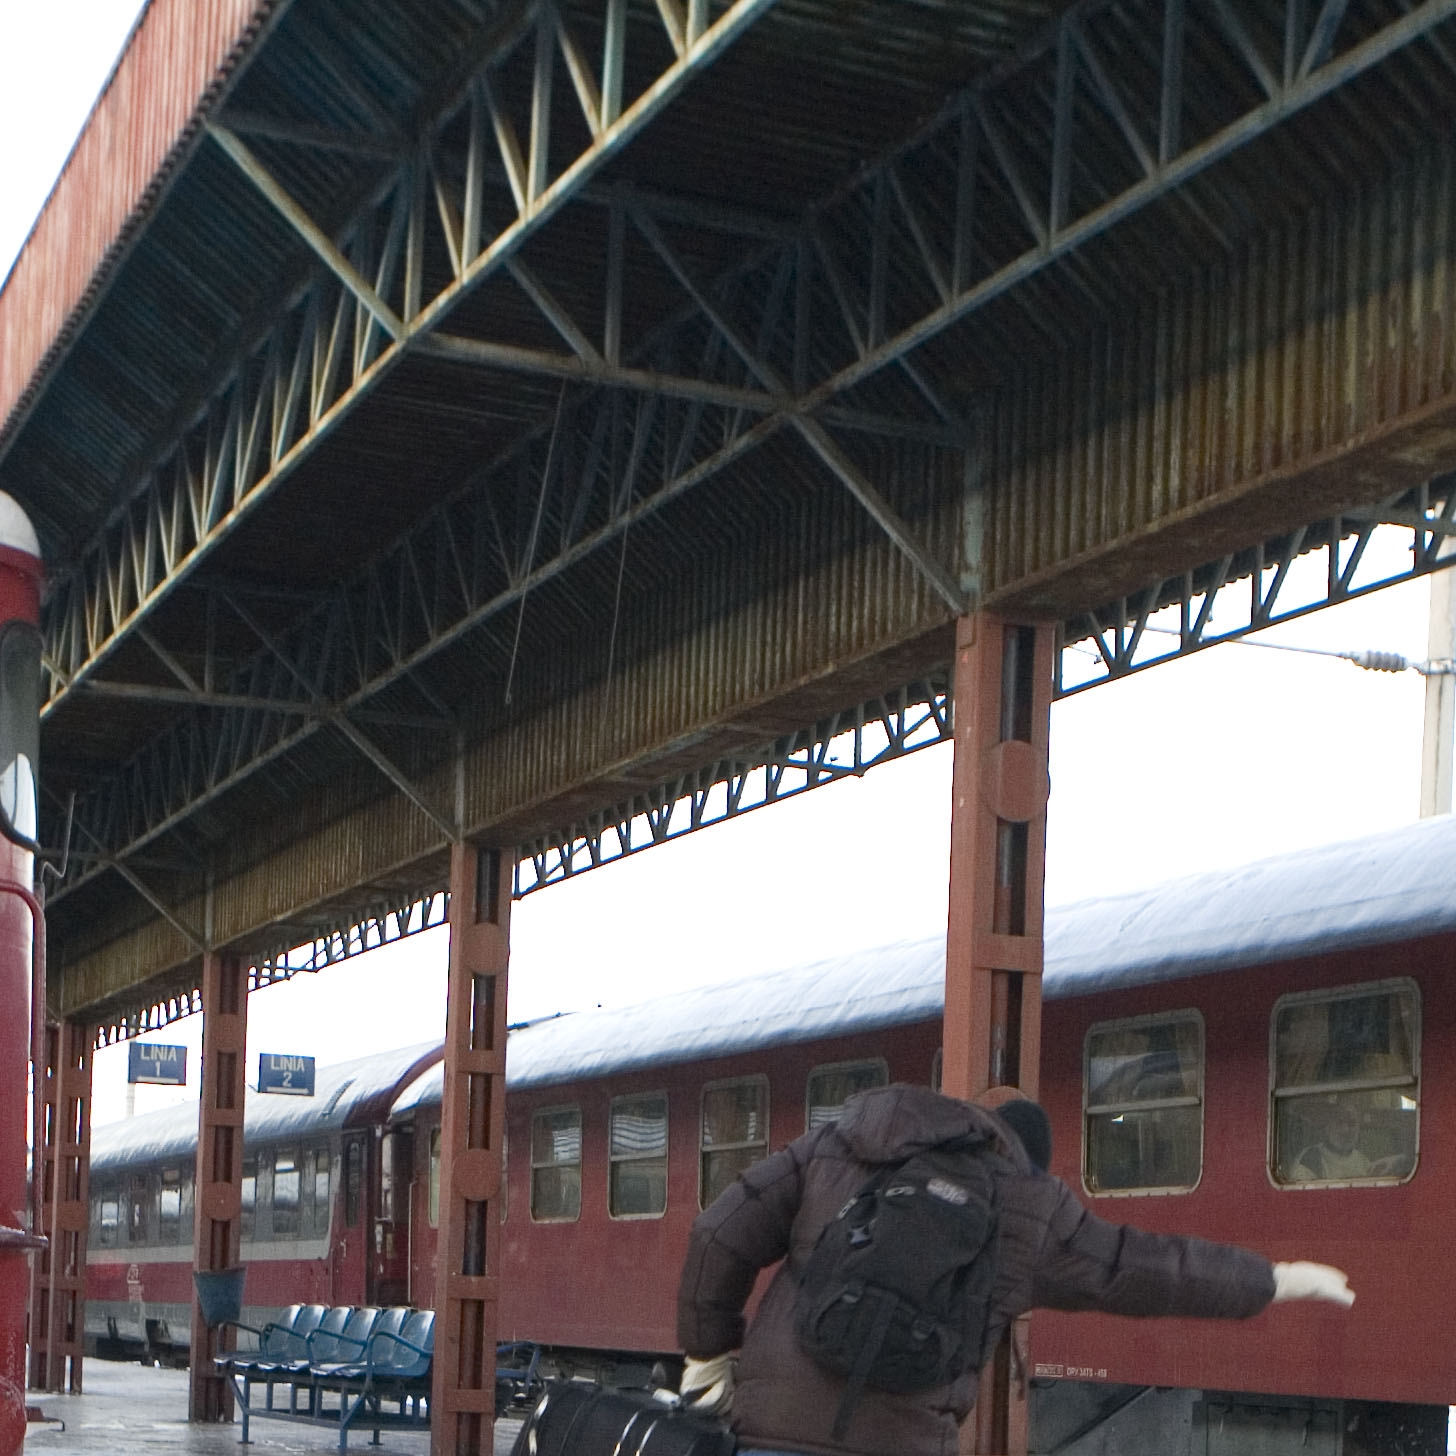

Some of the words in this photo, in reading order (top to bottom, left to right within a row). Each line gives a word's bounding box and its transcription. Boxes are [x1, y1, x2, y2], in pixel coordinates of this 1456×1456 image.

[141, 1044, 177, 1062] LINIA
[155, 1061, 161, 1077] 1
[271, 1055, 305, 1073] LINIA
[282, 1071, 292, 1087] 2
